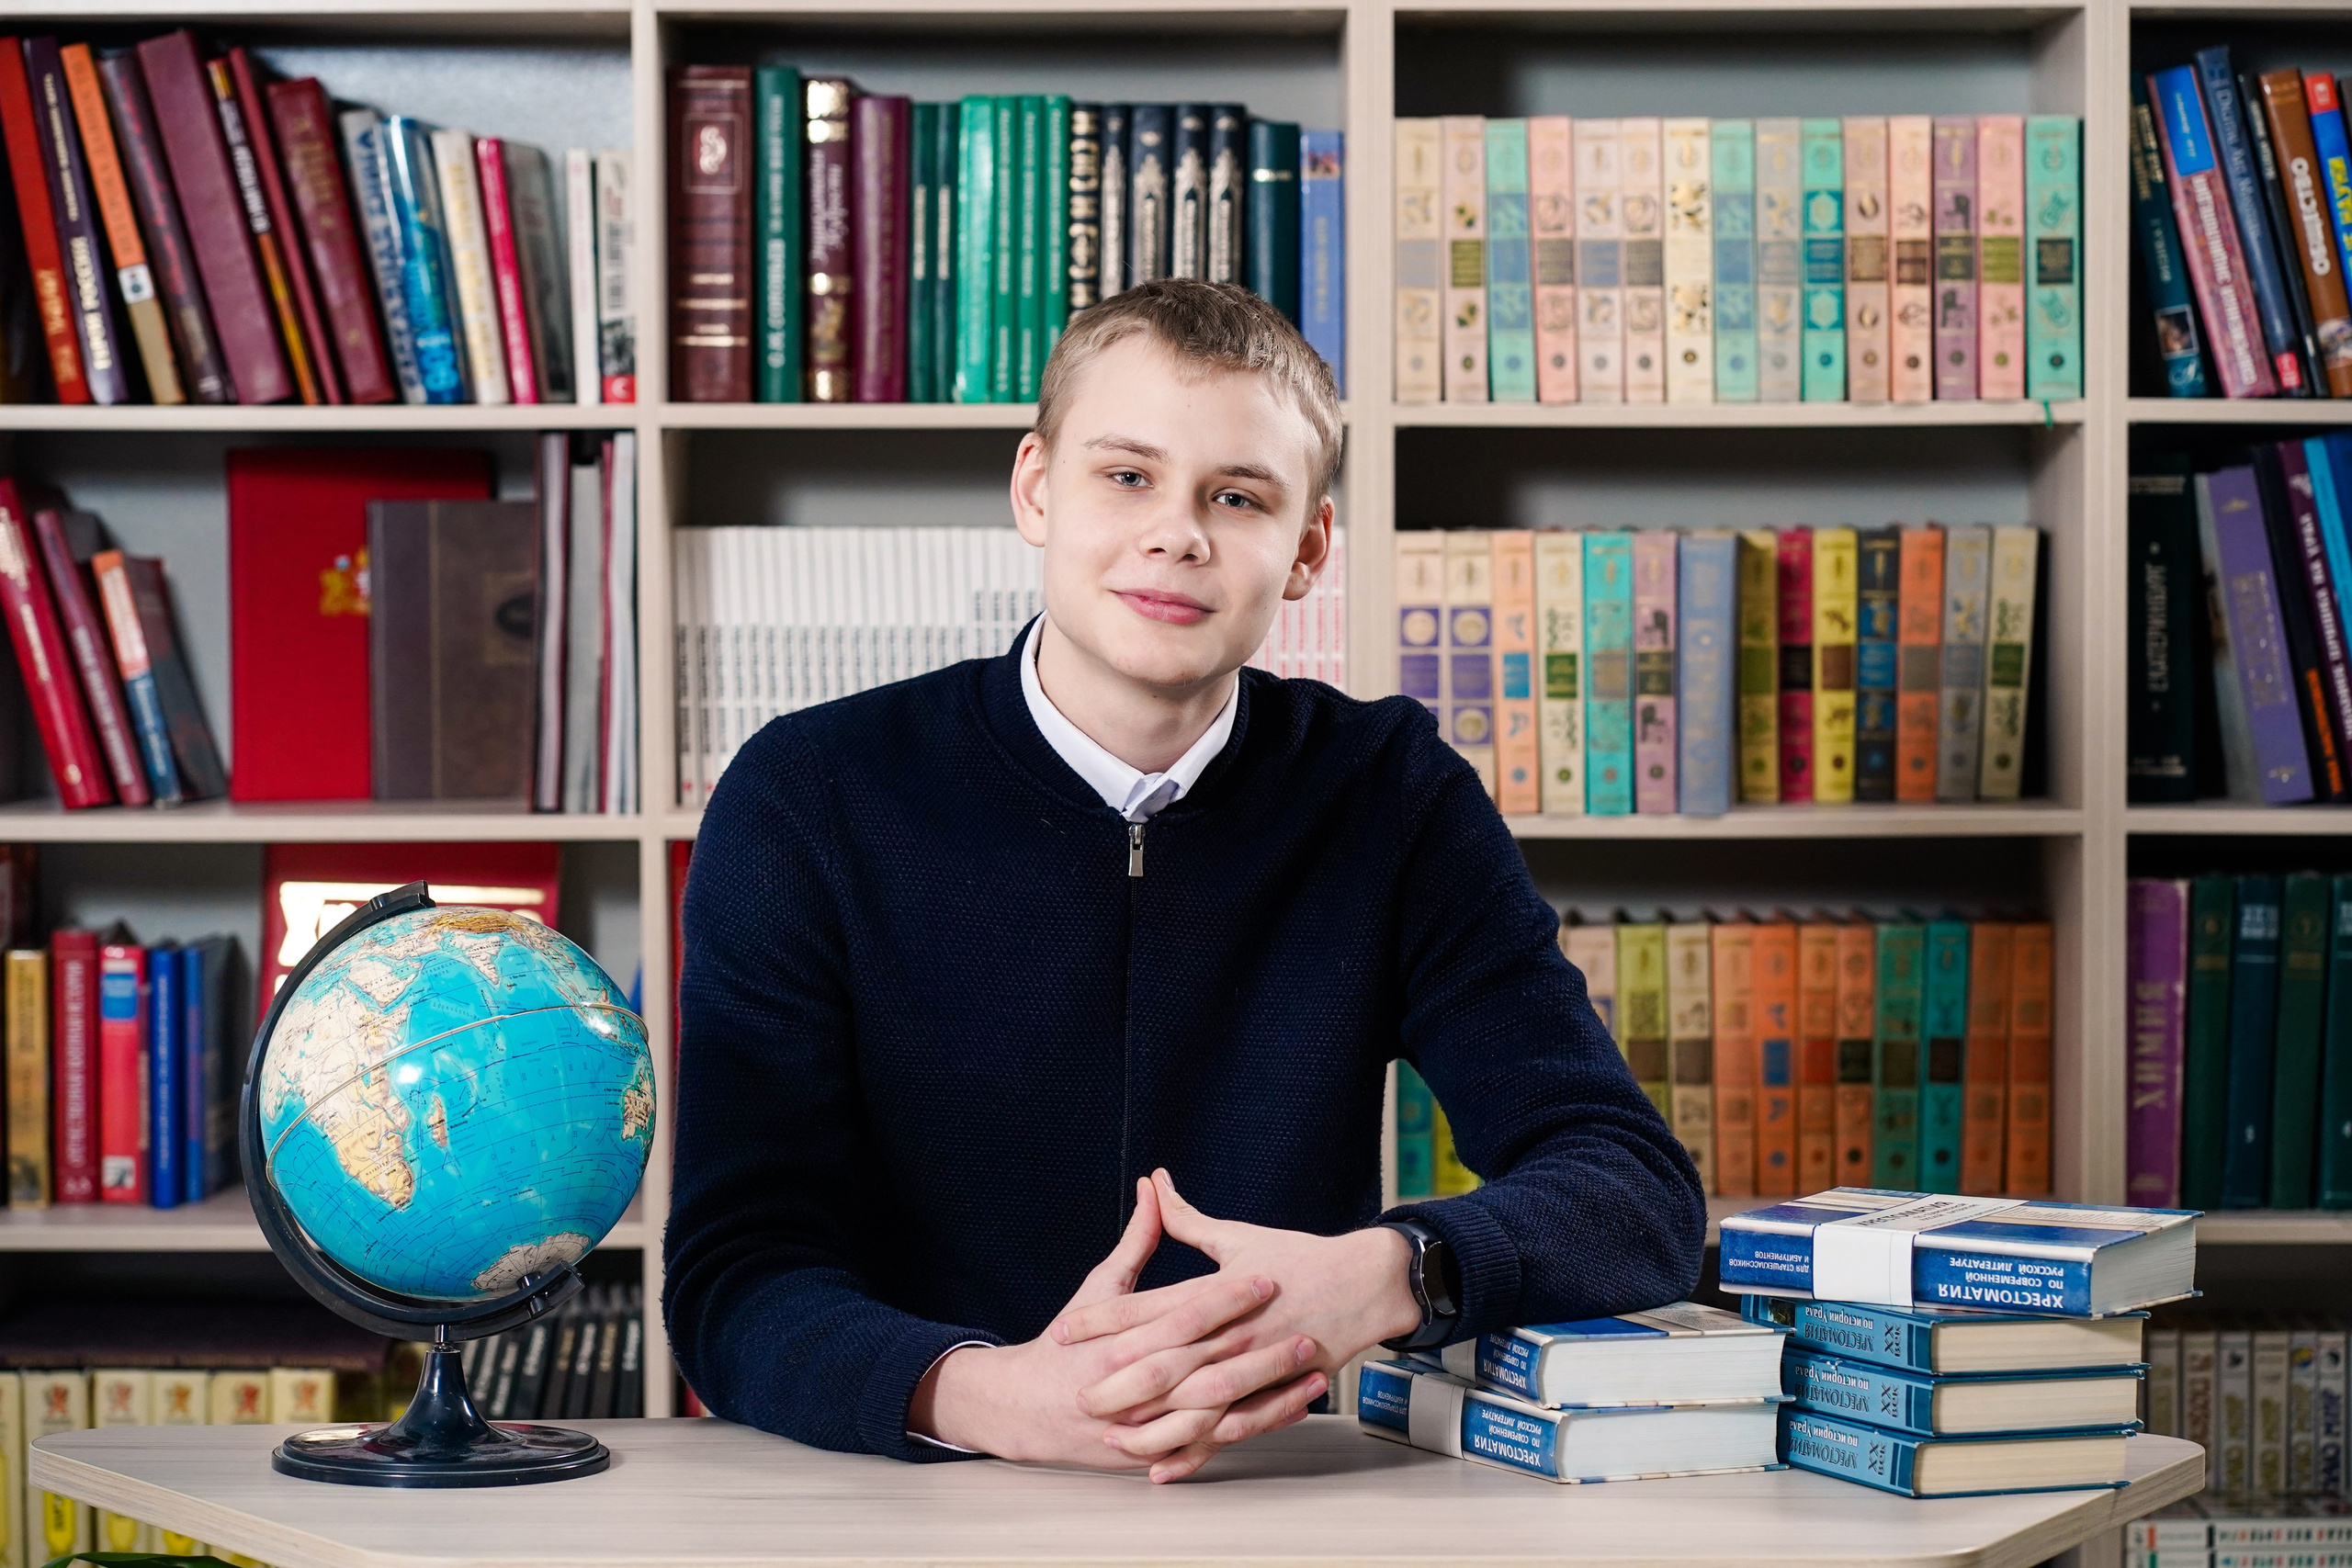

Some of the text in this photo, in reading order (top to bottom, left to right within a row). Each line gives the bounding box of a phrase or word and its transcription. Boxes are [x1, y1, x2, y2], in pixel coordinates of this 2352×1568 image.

[1728, 1258, 1810, 1273] ДЛЯ СТАРШЕКЛАССНИКОВ
[1754, 1250, 1804, 1262] АБИТУРИЕНТОВ
[1950, 1257, 2064, 1277] РУССКОЙ ЛИТЕРАТУРЕ
[1964, 1271, 2064, 1290] ПО СОВРЕМЕННОЙ
[1938, 1283, 2064, 1309] ХРЕСТОМАТИЯ
[1804, 1304, 1874, 1330] по истории Урала
[1804, 1322, 1874, 1352] ХРЕСТОМАТИЯ
[1493, 1348, 1527, 1371] ПО СОВРЕМЕННОЙ
[1511, 1343, 1530, 1358] РУССКОЙ
[1483, 1359, 1527, 1390] ХРЕСТОМАТИЯ
[1794, 1363, 1870, 1391] по истории Урала
[1795, 1382, 1871, 1413] ХРЕСТОМАТИЯ
[1481, 1409, 1543, 1435] РУССКОЙ ЛИТЕРАТУРЕ
[1789, 1418, 1859, 1447] по истории Урала
[1487, 1425, 1541, 1448] ПО СОВРЕМЕННОЙ
[1474, 1434, 1542, 1467] ХРЕСТОМАТИЯ
[1788, 1436, 1859, 1470] ХРЕСТОМАТИЯ
